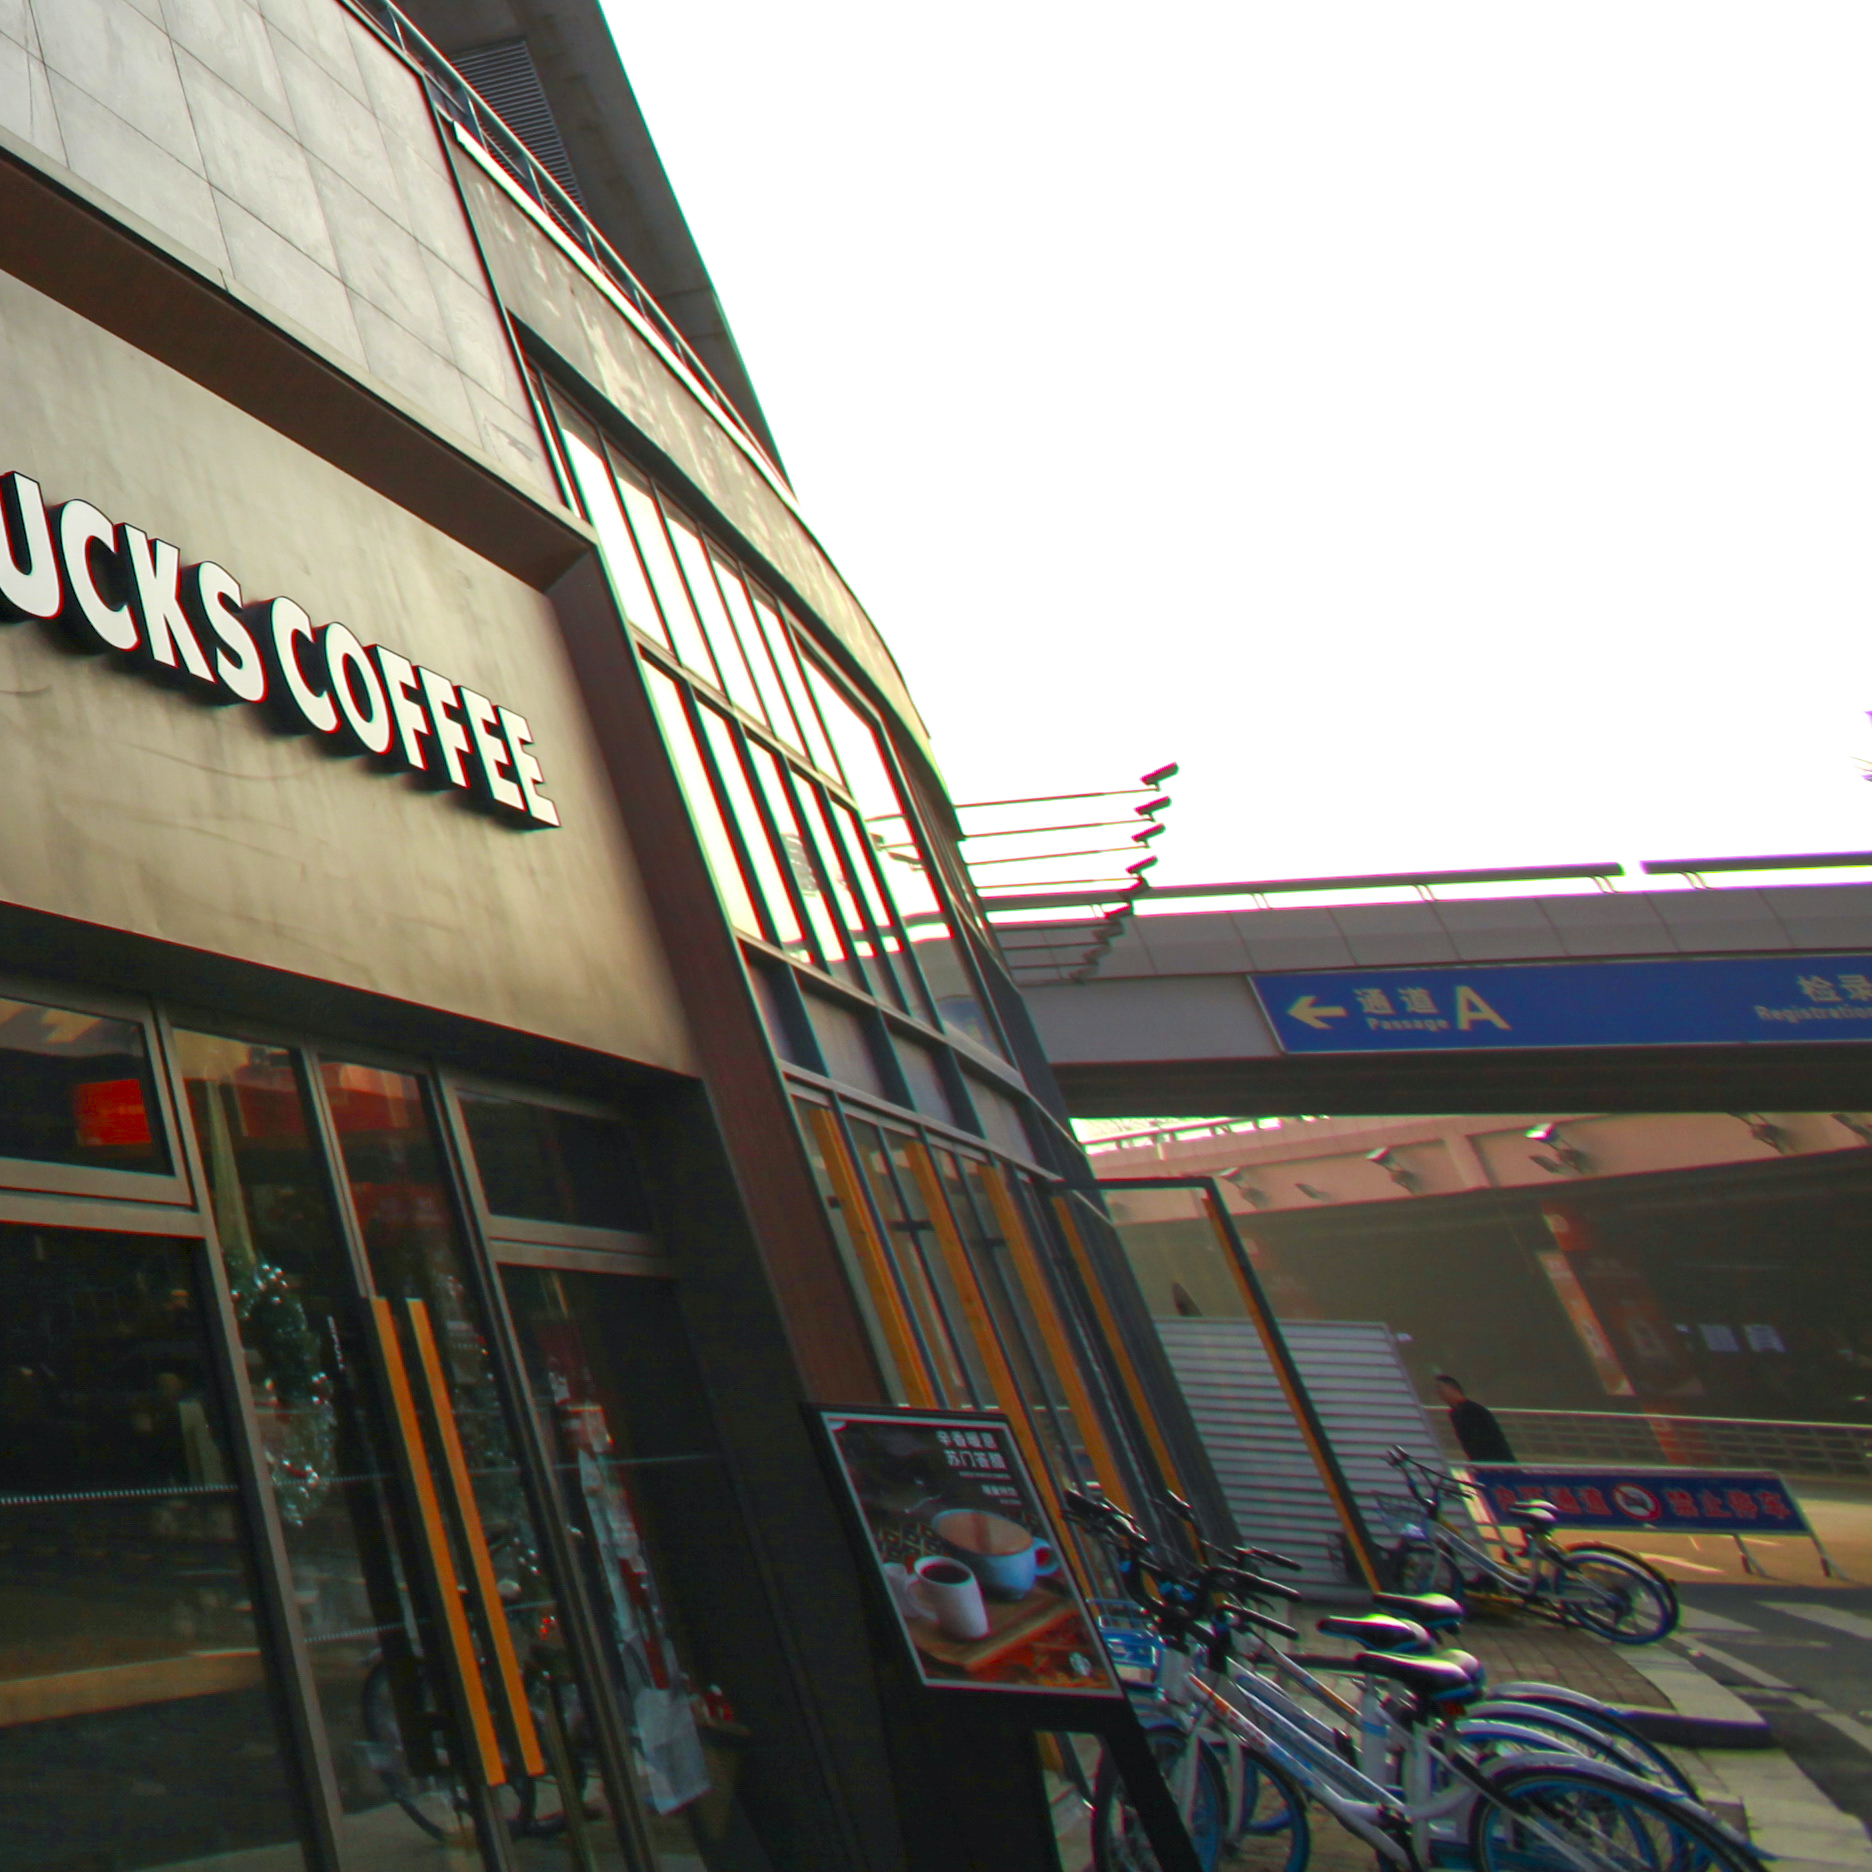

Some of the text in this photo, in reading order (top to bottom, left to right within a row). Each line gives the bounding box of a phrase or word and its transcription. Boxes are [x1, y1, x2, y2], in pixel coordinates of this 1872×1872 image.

[266, 595, 563, 830] COFFEE
[1354, 985, 1512, 1031] 通道 A
[1366, 1016, 1451, 1033] Passage
[1665, 1489, 1792, 1519] 禁止停车
